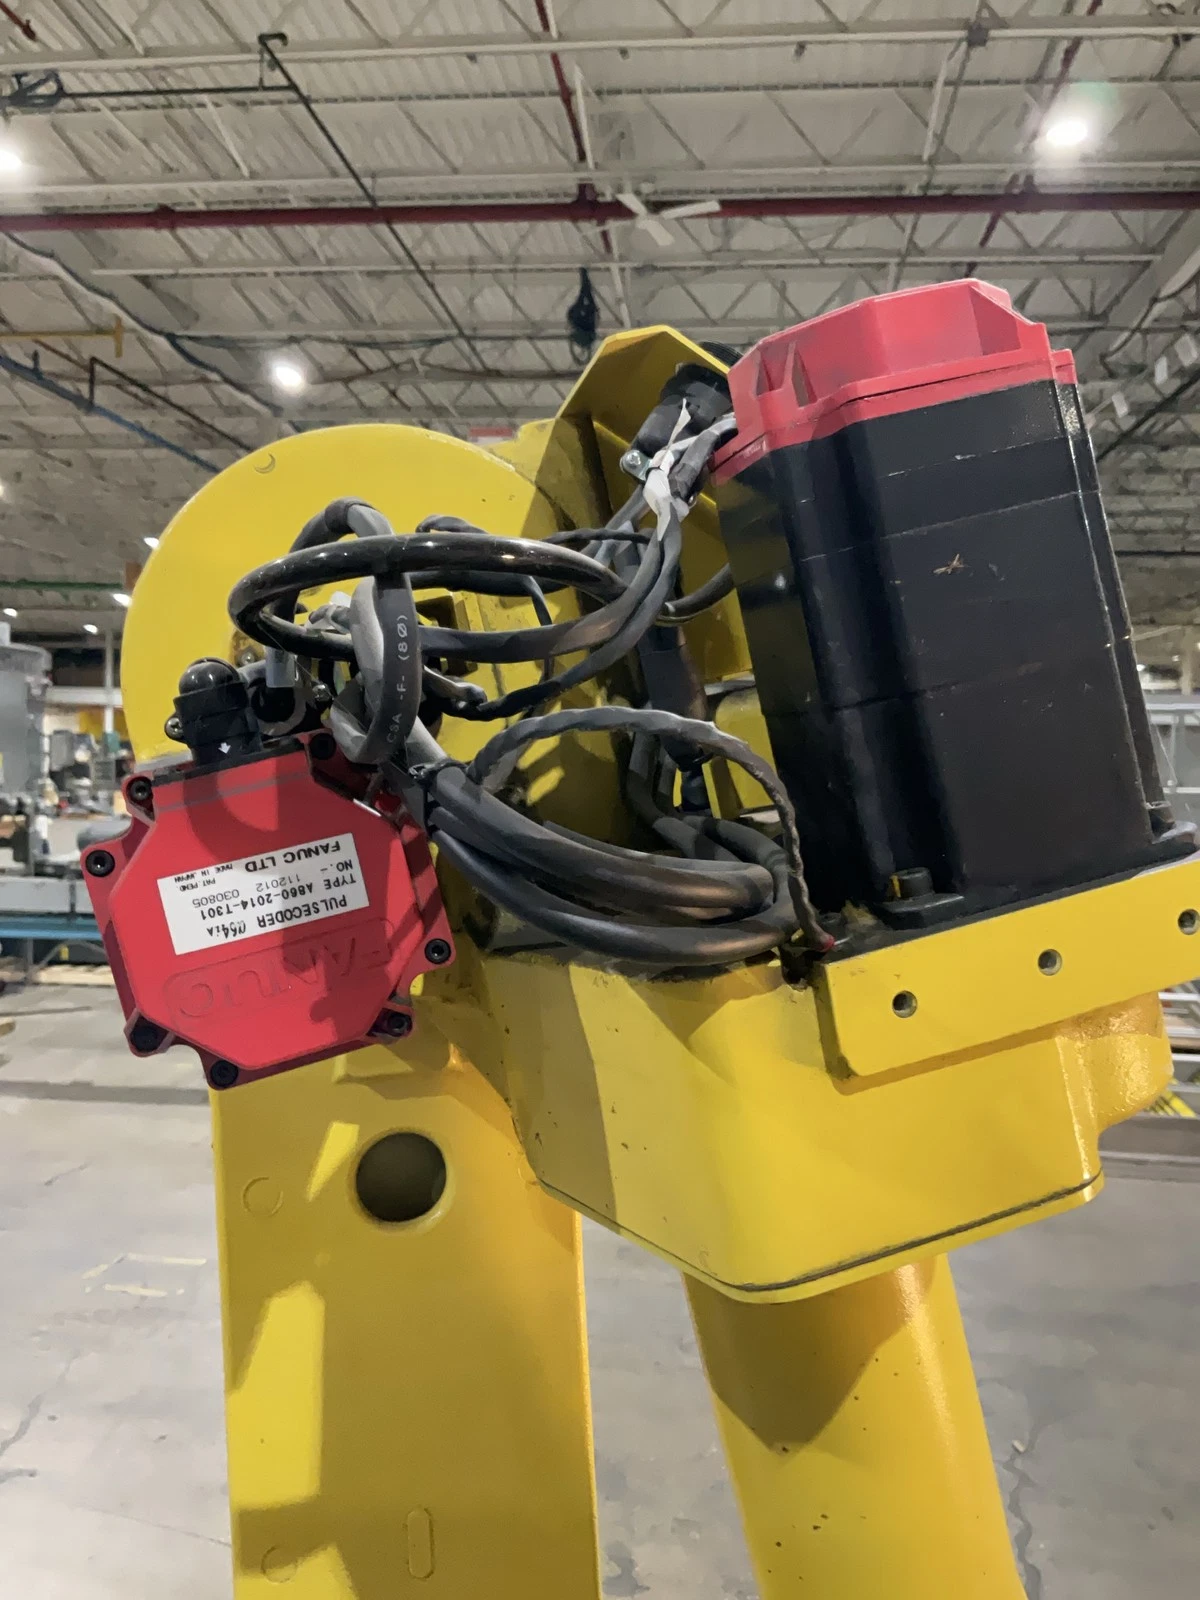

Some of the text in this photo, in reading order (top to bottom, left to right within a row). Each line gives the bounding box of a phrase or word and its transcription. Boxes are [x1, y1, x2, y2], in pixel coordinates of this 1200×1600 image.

[387, 713, 402, 743] CSA
[245, 841, 341, 873] FANUC LTD
[174, 863, 233, 883] MADE IN JAPAN
[255, 874, 300, 892] 112012
[192, 889, 240, 908] 030805
[200, 874, 356, 921] TYPE A860-2014-T301
[257, 894, 348, 928] PULSECODER
[179, 938, 390, 1017] FANUC
